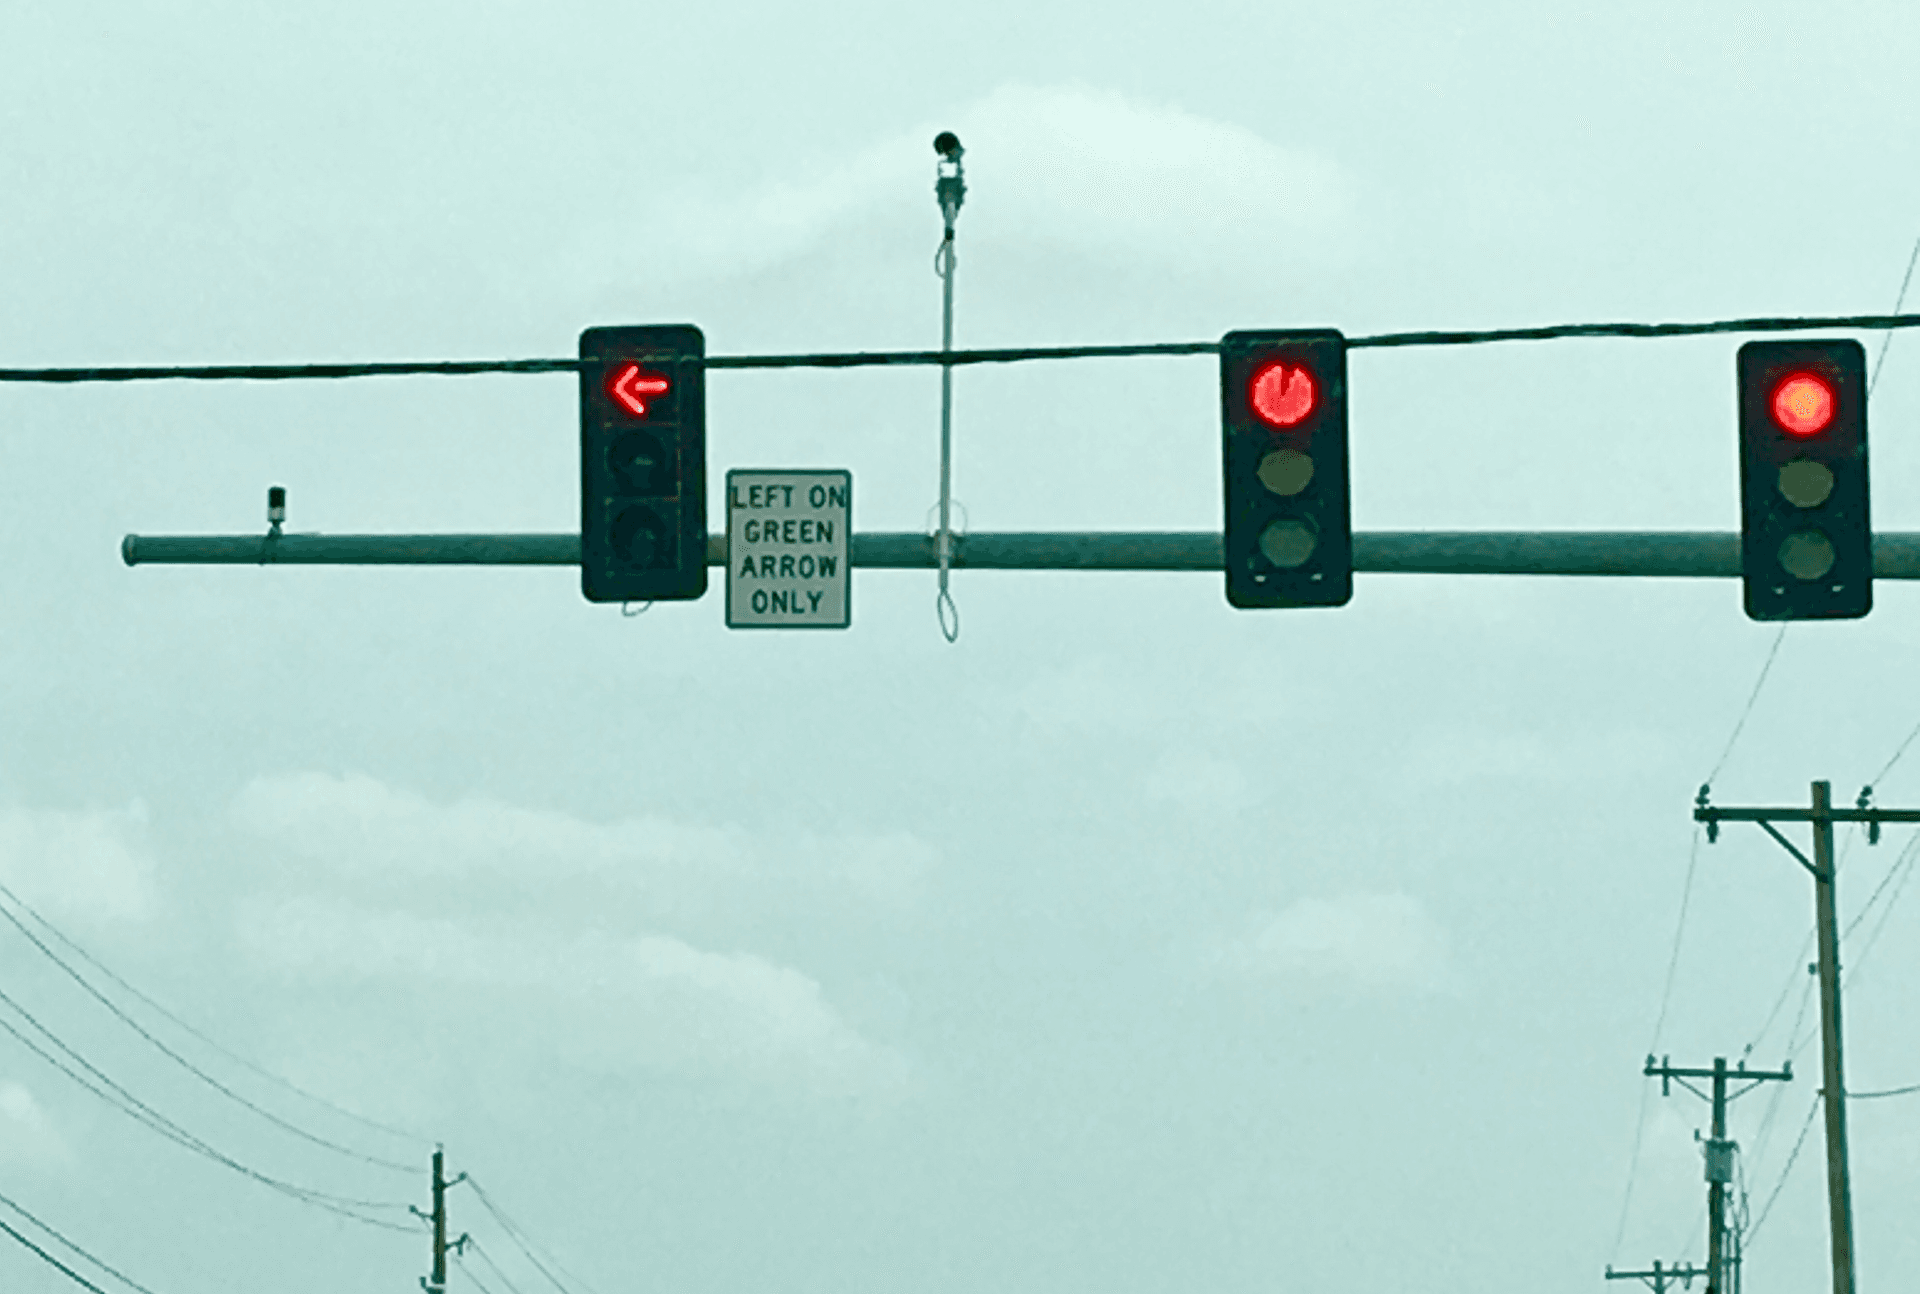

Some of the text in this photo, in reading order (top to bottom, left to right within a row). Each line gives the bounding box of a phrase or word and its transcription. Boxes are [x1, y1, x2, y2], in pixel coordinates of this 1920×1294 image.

[732, 485, 846, 509] LEFT ON
[744, 519, 833, 544] GREEN
[739, 554, 838, 579] ARROW
[751, 589, 824, 614] ONLY
